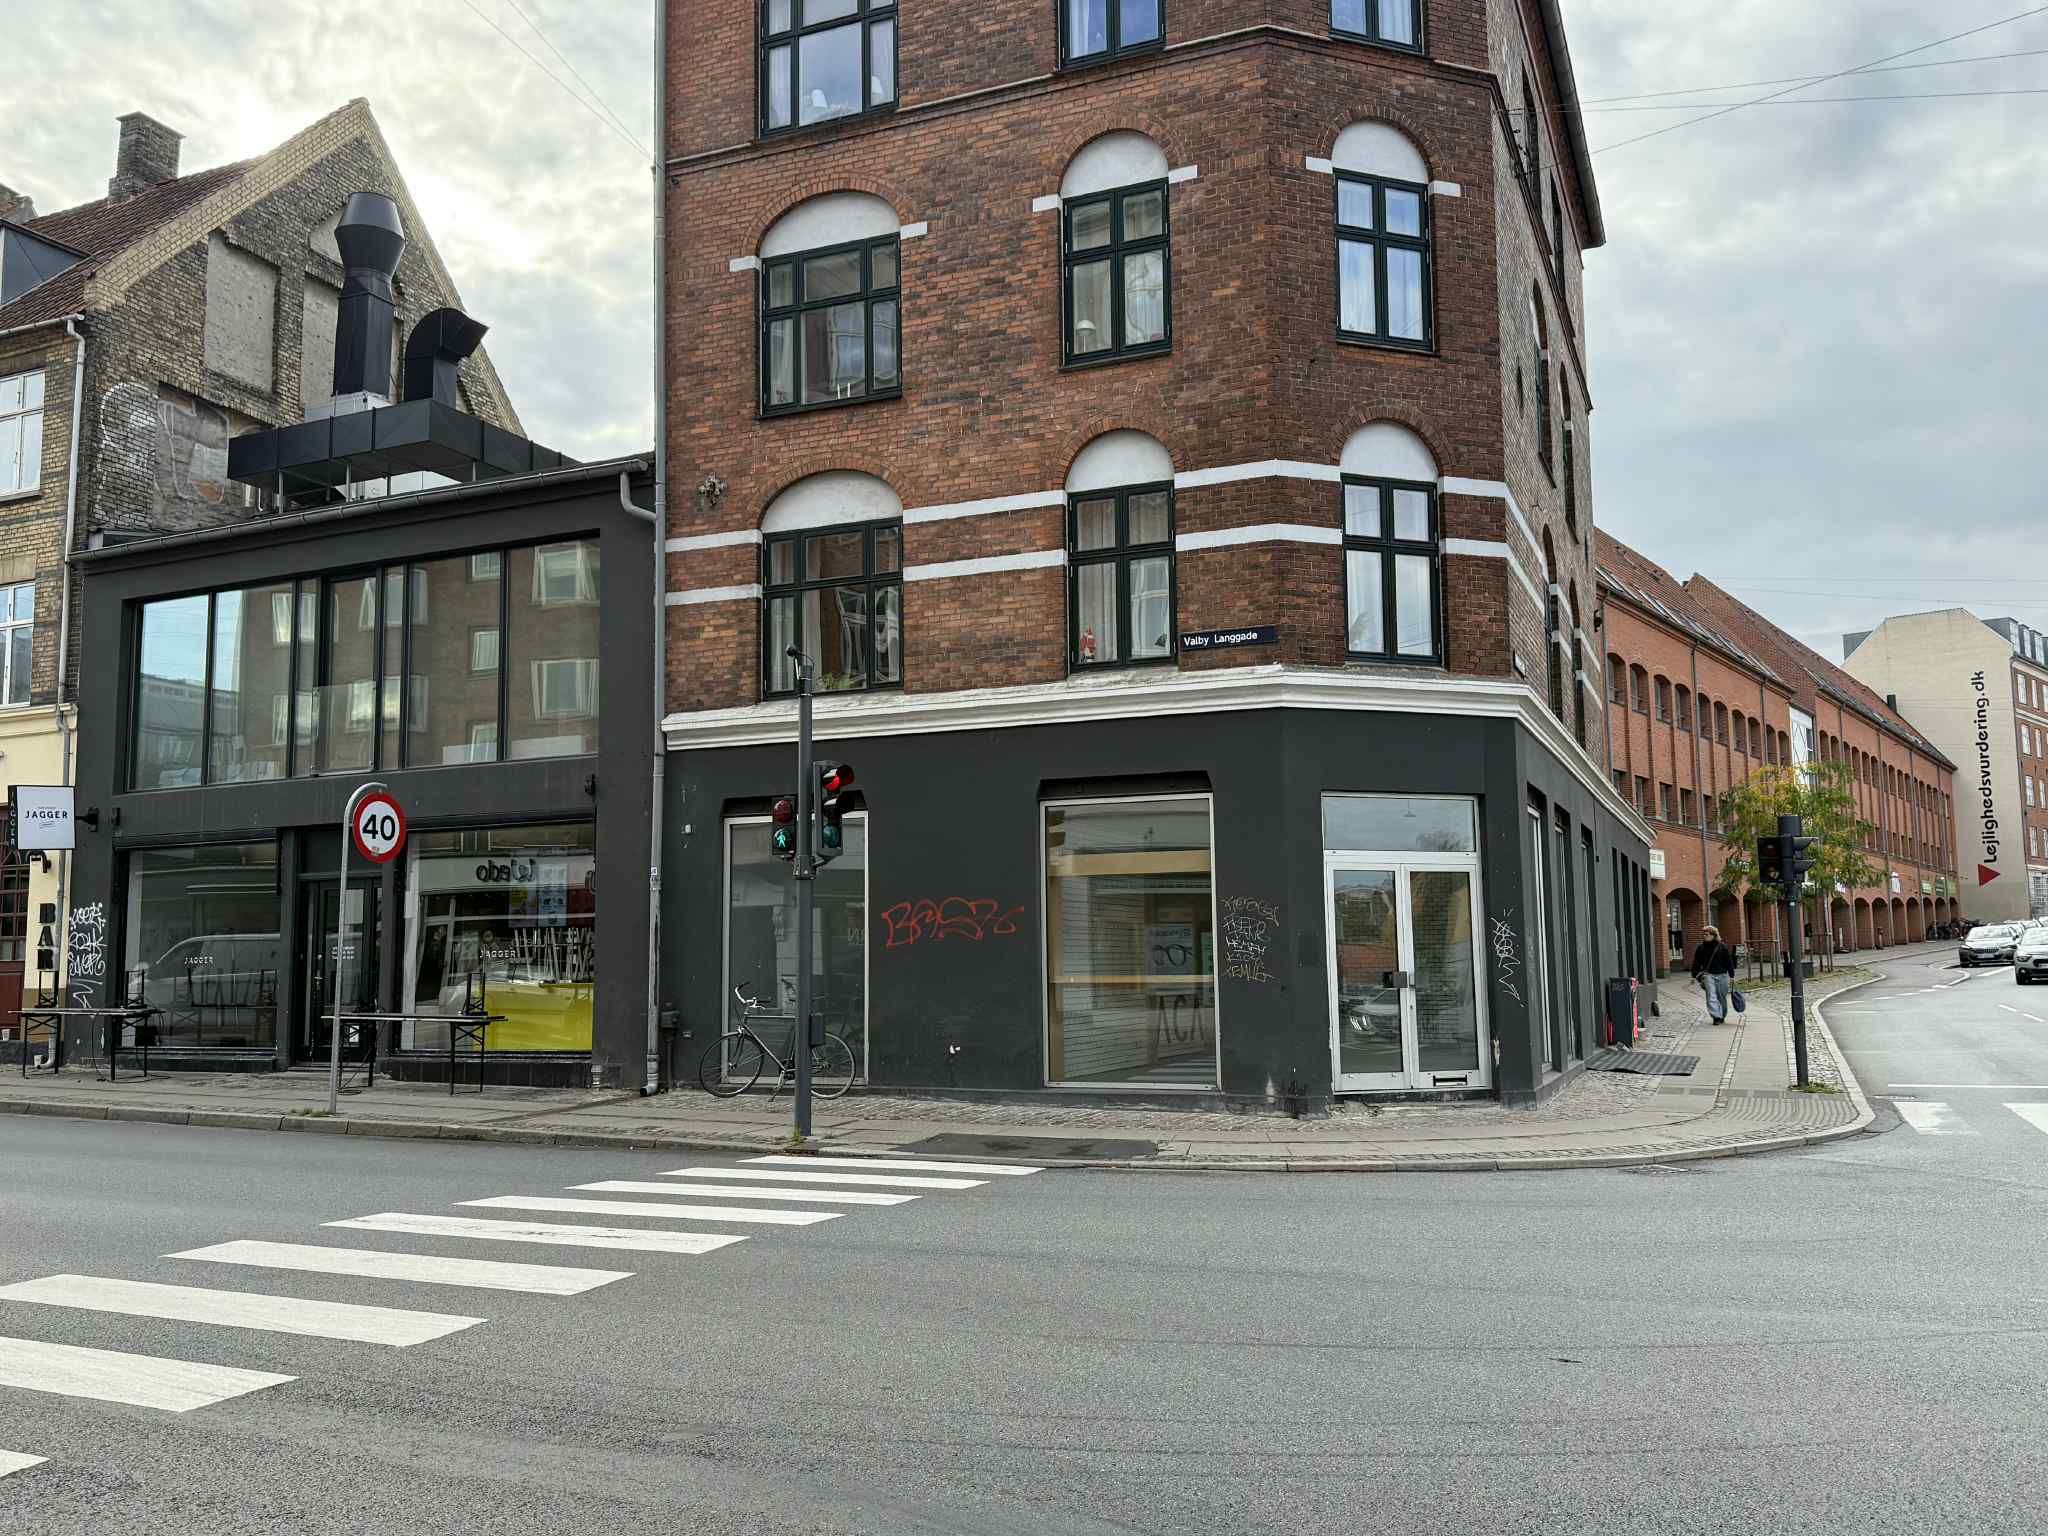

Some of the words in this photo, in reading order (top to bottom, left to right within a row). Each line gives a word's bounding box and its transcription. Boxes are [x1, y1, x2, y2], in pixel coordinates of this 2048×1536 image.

[1183, 636, 1209, 646] Valby
[1214, 631, 1258, 644] Langgade
[1971, 670, 2000, 863] Lejlighedsvurdering.dk
[25, 810, 68, 819] JAGGER
[362, 814, 396, 841] 40
[37, 903, 56, 969] BAR
[480, 950, 516, 958] JAGGER
